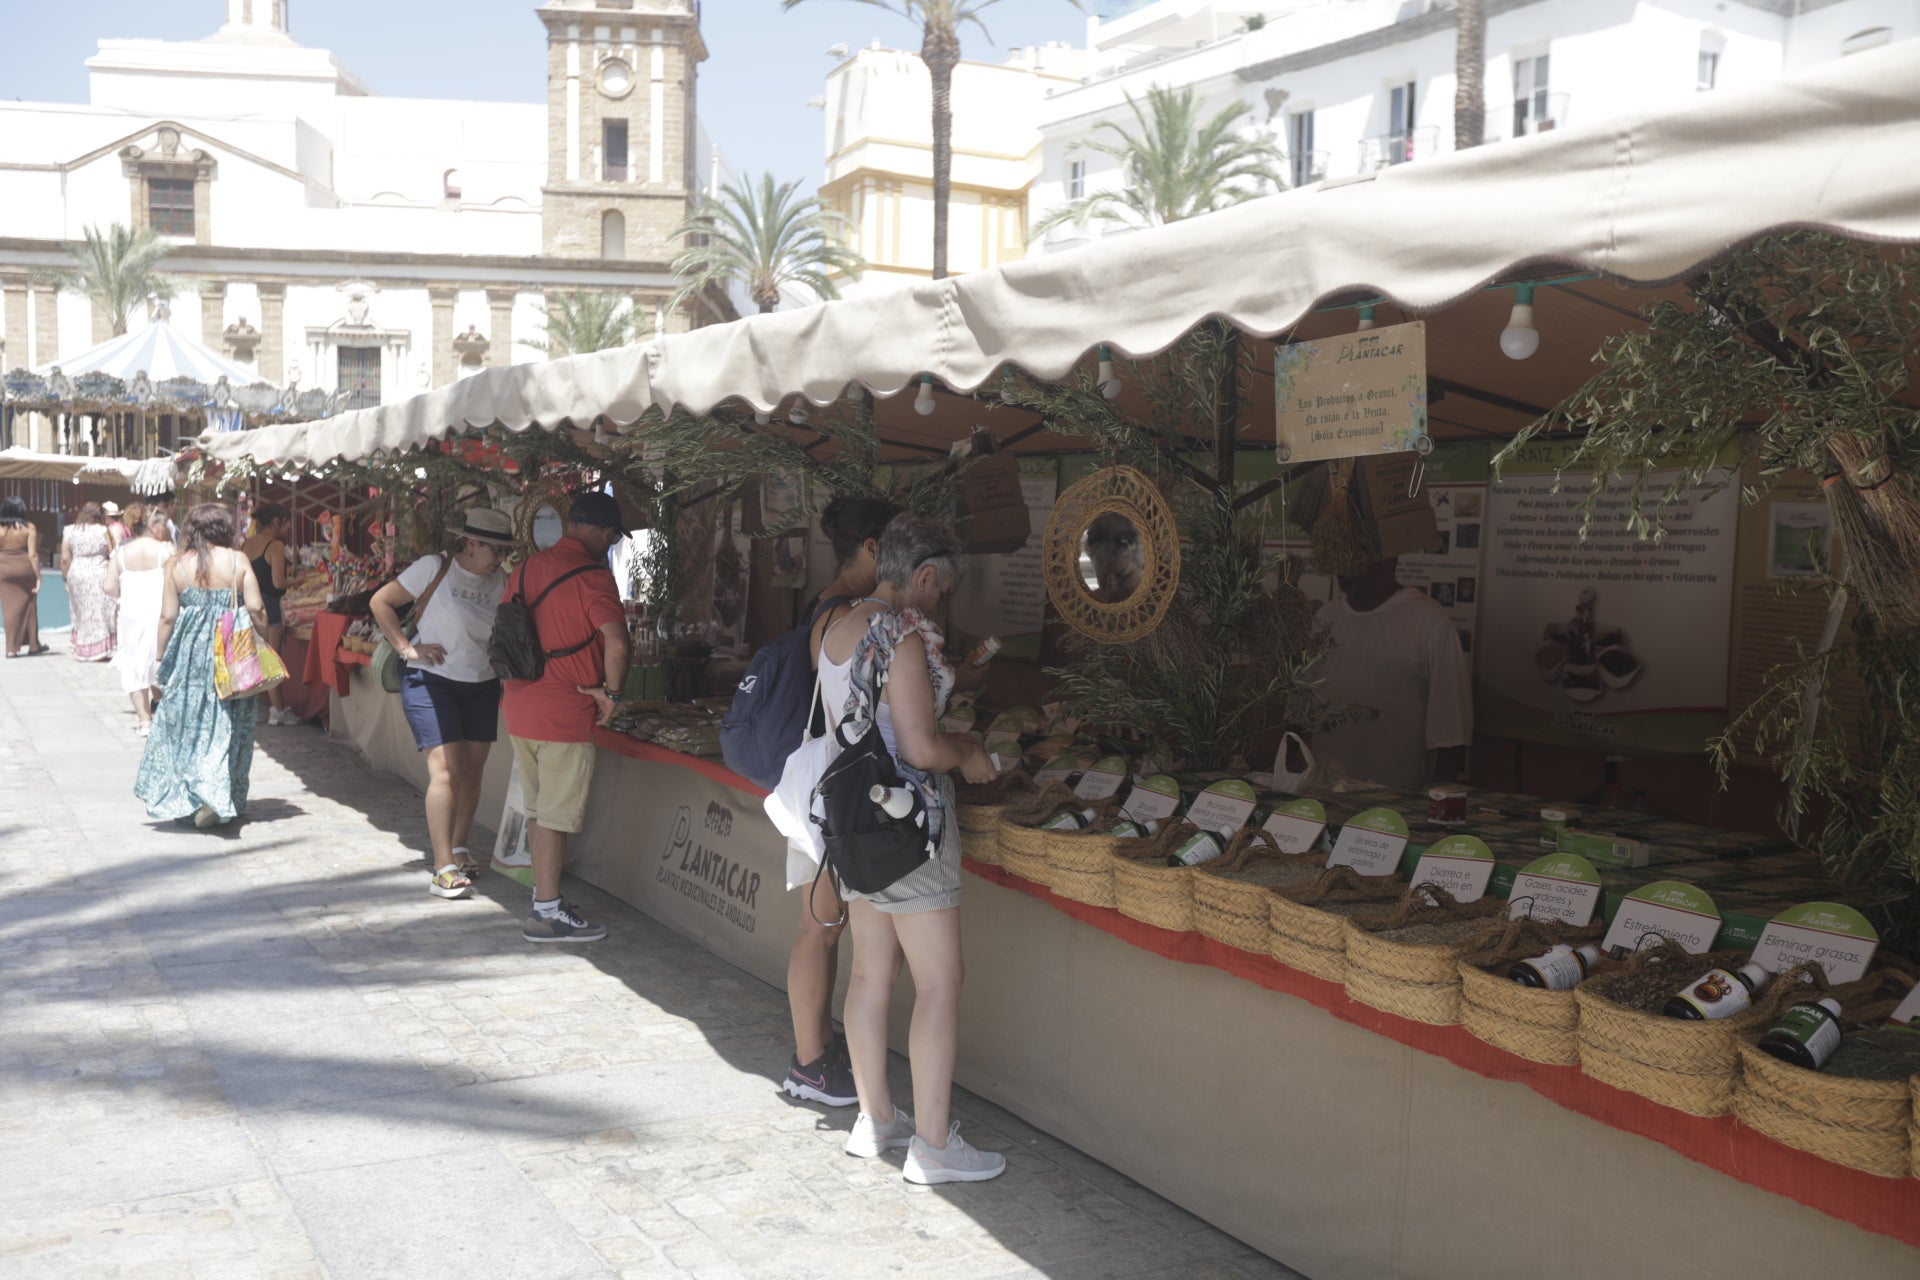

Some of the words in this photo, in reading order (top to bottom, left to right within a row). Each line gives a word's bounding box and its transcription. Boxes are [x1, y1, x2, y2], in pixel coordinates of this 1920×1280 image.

[1336, 344, 1405, 364] PLANTACAR
[1297, 398, 1312, 412] Los
[1316, 394, 1355, 410] Productos
[1358, 393, 1363, 401] a
[1320, 411, 1341, 424] están
[1344, 412, 1349, 421] a
[1663, 542, 1707, 554] Verrugas
[1672, 572, 1718, 584] Urticaria
[662, 805, 761, 910] PLANTACAR
[1430, 866, 1464, 879] Diarrea
[1464, 872, 1471, 880] e
[655, 866, 681, 890] PLANTAS
[679, 877, 718, 911] MEDICINALES
[717, 898, 726, 917] DE
[1460, 882, 1473, 892] en
[1532, 892, 1566, 905] ardores
[1568, 898, 1574, 907] y
[1562, 907, 1576, 918] de
[1623, 918, 1701, 946] Estreñimiento
[1764, 934, 1814, 954] Eliminar
[1816, 945, 1862, 964] grasas,
[1827, 963, 1838, 973] y
